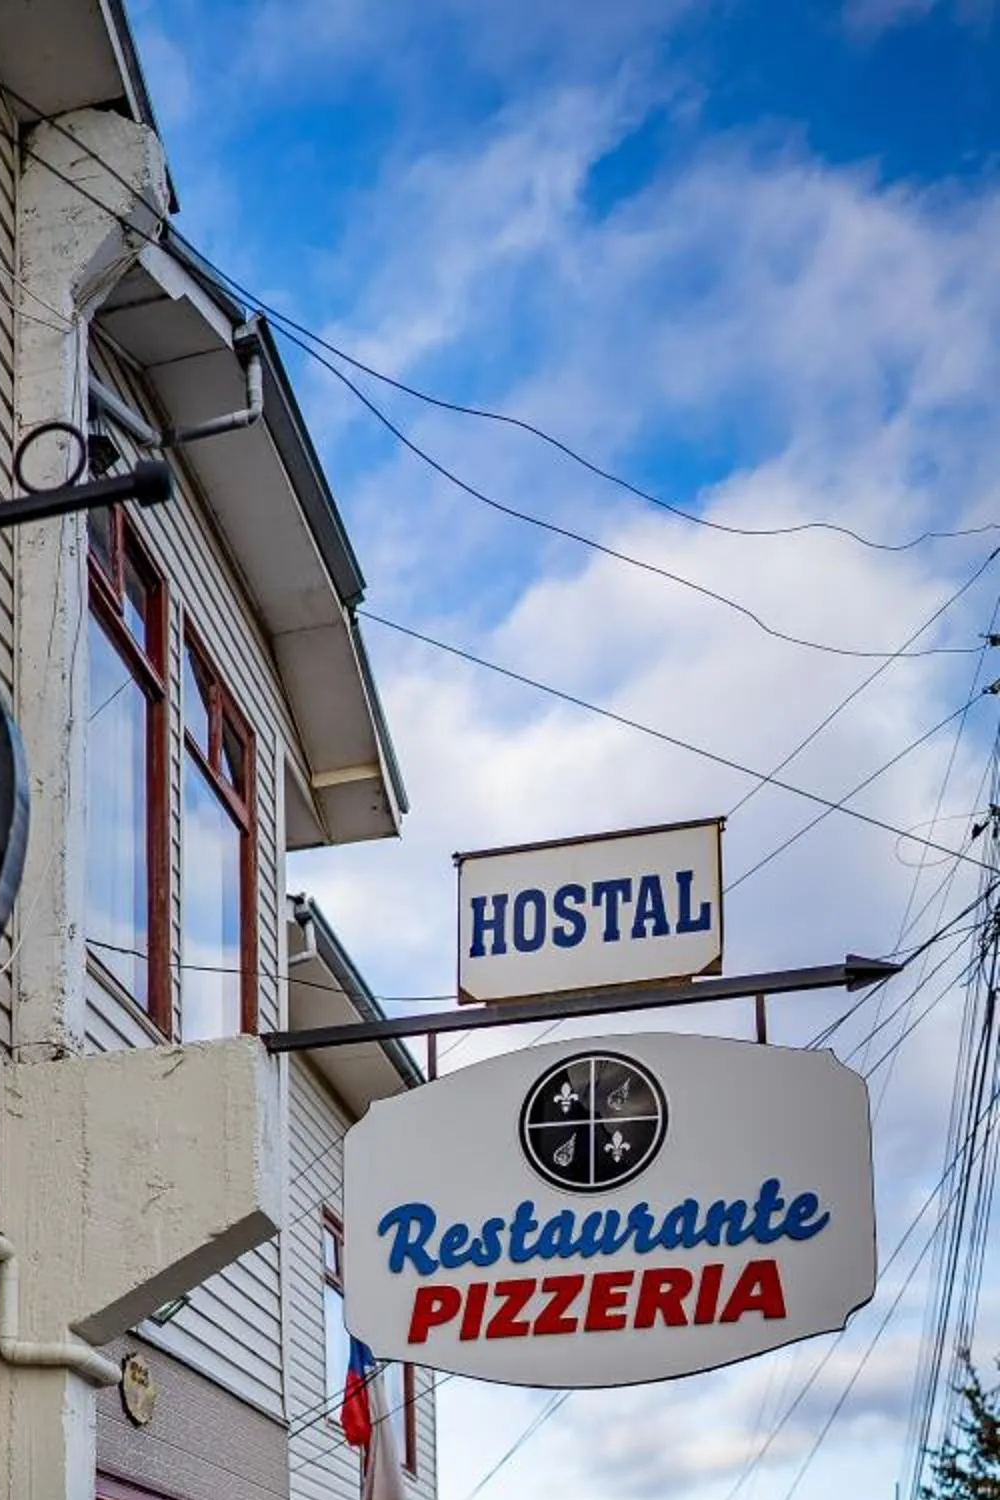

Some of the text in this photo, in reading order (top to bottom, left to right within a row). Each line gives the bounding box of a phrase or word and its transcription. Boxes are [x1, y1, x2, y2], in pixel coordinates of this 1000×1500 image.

[469, 870, 712, 958] HOSTAL
[378, 1178, 831, 1276] Restaurante
[407, 1259, 786, 1345] PIZZERIA
